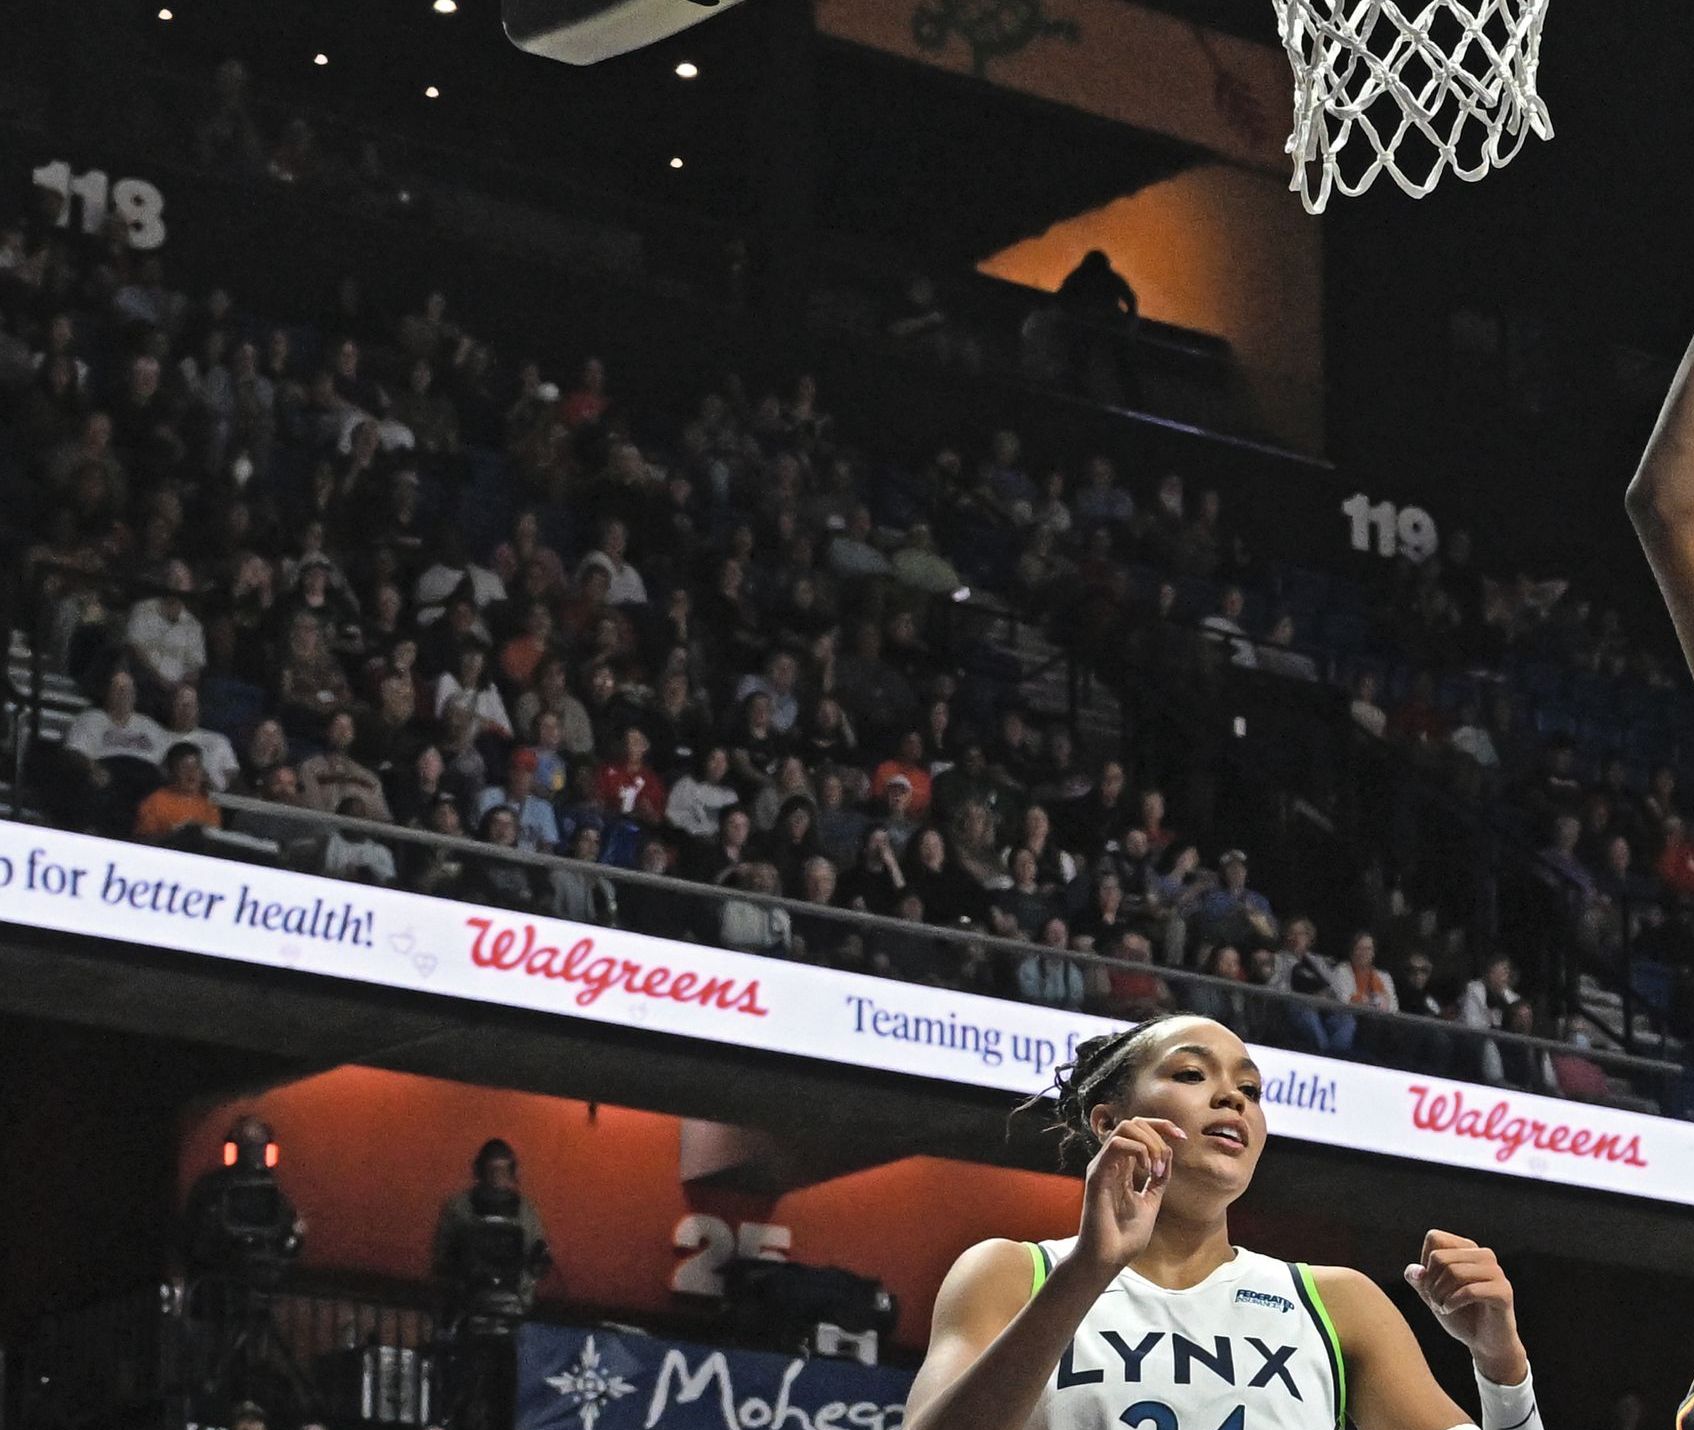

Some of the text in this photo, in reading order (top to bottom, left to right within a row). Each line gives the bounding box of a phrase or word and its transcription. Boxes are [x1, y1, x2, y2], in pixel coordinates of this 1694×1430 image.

[33, 161, 165, 249] 118
[1341, 493, 1438, 563] 119
[26, 847, 86, 897] for
[100, 862, 225, 920] better
[234, 885, 374, 947] health!
[465, 916, 768, 1017] Walgreens
[846, 994, 1002, 1066] Teaming
[1012, 1038, 1056, 1074] up
[1408, 1084, 1647, 1167] Walgreens
[1056, 1330, 1304, 1403] LYNX
